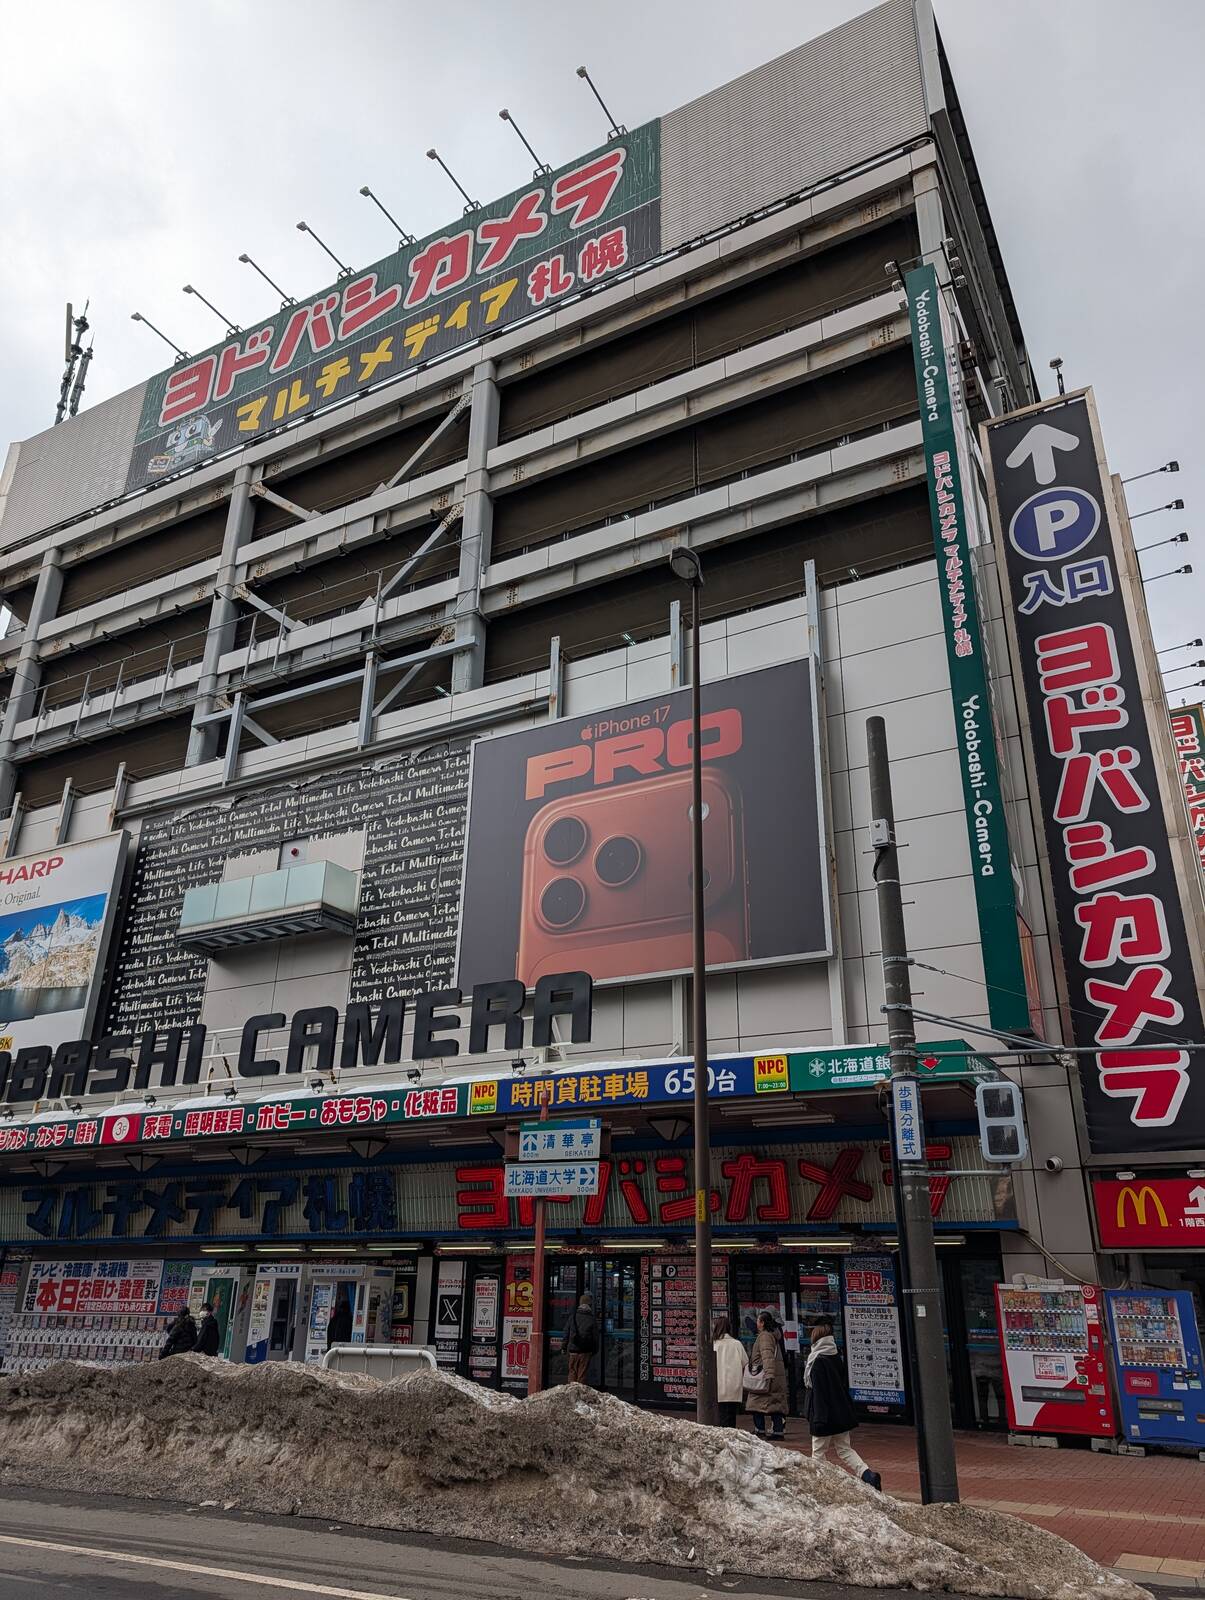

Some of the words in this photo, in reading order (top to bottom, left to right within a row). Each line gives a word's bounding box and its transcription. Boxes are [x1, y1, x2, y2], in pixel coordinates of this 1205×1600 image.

[157, 146, 626, 428] ヨドバシカメラ
[914, 289, 940, 424] Yodobashi-Camera
[1034, 499, 1080, 553] P
[1018, 555, 1115, 616] 入口
[594, 713, 650, 740] iPhone
[653, 704, 671, 725] 17
[525, 708, 743, 801] PRO
[171, 825, 186, 837] Life
[189, 815, 226, 832] Yodobashi
[230, 808, 257, 823] Camera
[260, 800, 282, 814] Total
[285, 788, 333, 809] Multimedia
[337, 784, 356, 797] Life
[359, 770, 404, 791] Yodobashi
[408, 764, 441, 780] Camera
[444, 753, 470, 771] Total
[960, 695, 995, 878] Yodobashi-Camera
[181, 841, 209, 854] Camera
[211, 833, 231, 847] Total
[234, 821, 281, 841] Multimedia
[284, 817, 302, 830] Life
[305, 805, 348, 825] Yodobashi
[351, 800, 384, 814] Camera
[387, 791, 412, 806] Total
[415, 778, 470, 800] Multimedia
[385, 808, 433, 828] Yodobashi
[400, 833, 436, 849] Camera
[438, 825, 465, 840] Total
[144, 864, 186, 882] Multimedia
[189, 861, 205, 872] Life
[380, 861, 405, 877] Total
[408, 850, 464, 870] Multimedia
[1034, 622, 1192, 1129] ヨドバシカメラ
[159, 888, 176, 899] Life
[378, 880, 427, 900] Yodobashi
[393, 911, 430, 924] Camera
[432, 900, 459, 917] Total
[131, 928, 175, 946] Multimedia
[371, 934, 398, 950] Total
[401, 925, 459, 945] Multimedia
[147, 955, 164, 967] Life
[370, 956, 420, 976] Yodobashi
[158, 972, 187, 985] Camera
[386, 985, 423, 998] Camera
[119, 997, 163, 1014] Multimedia
[166, 993, 182, 1005] Life
[134, 1021, 151, 1034] Life
[154, 1015, 194, 1031] Yodobashi
[238, 970, 594, 1078] CAMERA
[757, 1059, 785, 1075] NPC
[474, 1084, 495, 1098] NPC
[510, 1071, 649, 1107] 時間貸駐車場
[115, 1121, 127, 1136] 3F
[897, 1085, 916, 1156] 歩車分離式
[543, 1133, 594, 1149] 清華亭
[508, 1168, 576, 1186] 北海道大学
[508, 1186, 533, 1194] HOKKAIDO
[535, 1186, 564, 1194] UNIVERSITY
[22, 1170, 398, 1237] マルチメディア札幌
[32, 1262, 129, 1278] テレビ・冷蔵庫・洗濯機
[845, 1270, 883, 1293] 買取
[24, 1279, 39, 1311] 最短
[36, 1278, 81, 1312] 本日
[79, 1279, 146, 1300] お届け・設置
